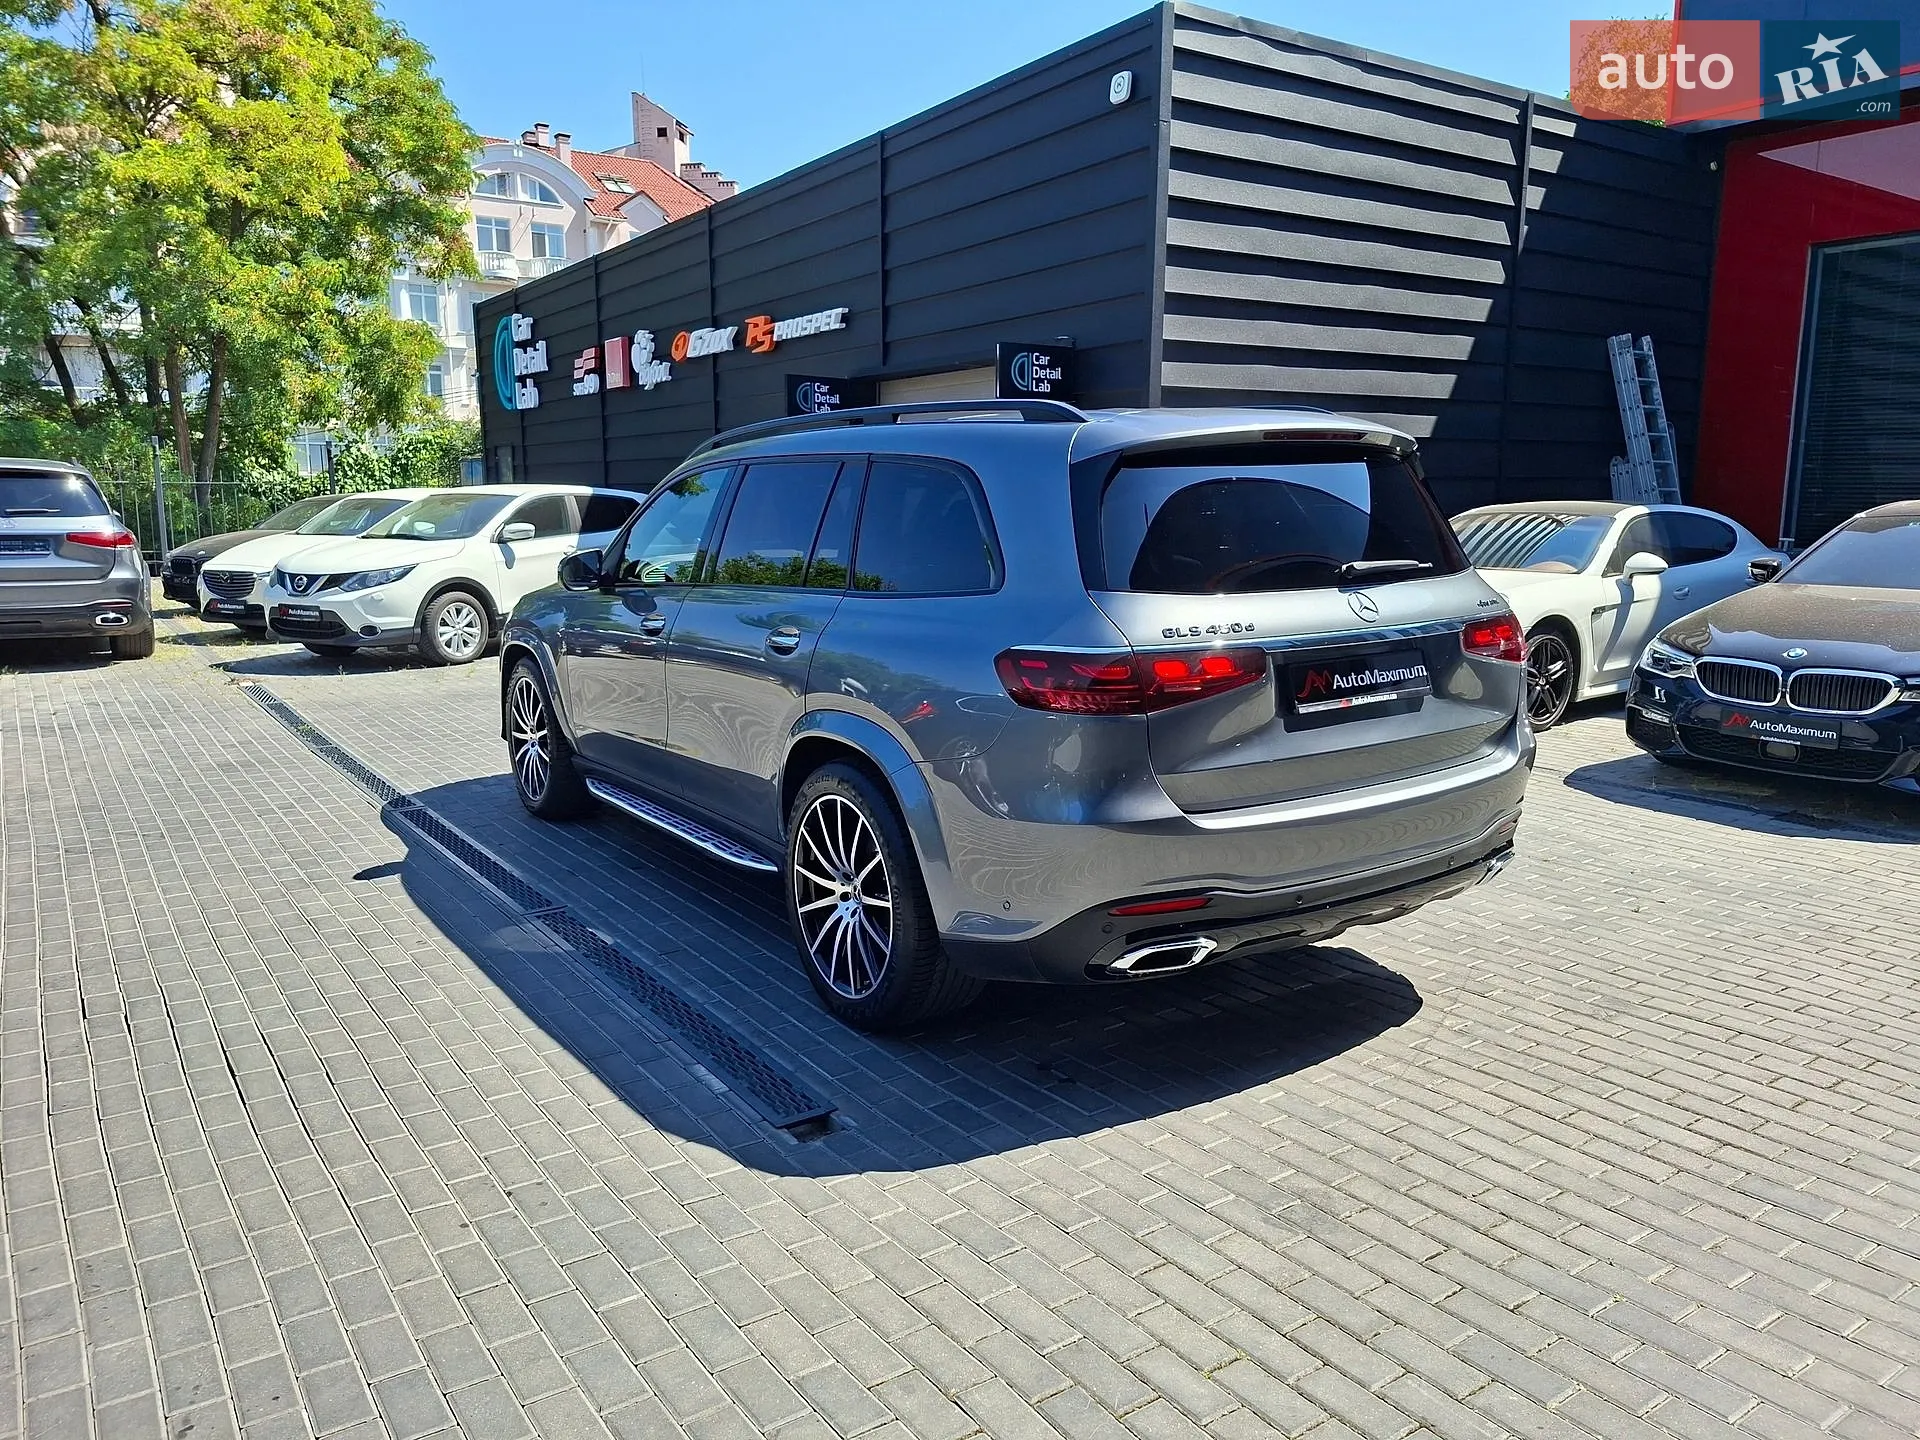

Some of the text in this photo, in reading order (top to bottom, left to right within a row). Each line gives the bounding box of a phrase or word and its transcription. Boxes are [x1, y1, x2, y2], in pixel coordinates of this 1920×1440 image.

[511, 313, 534, 342] Car
[772, 307, 849, 341] PROSPEC
[513, 340, 549, 376] Detail
[1032, 352, 1051, 365] Car
[1032, 366, 1062, 380] Detail
[814, 382, 830, 393] Car
[1032, 379, 1051, 392] Lab
[515, 378, 540, 410] Lab
[814, 393, 840, 404] Detail
[814, 403, 831, 413] Lab
[1161, 626, 1202, 639] GLS
[1332, 664, 1428, 690] AutoMaximum
[1749, 719, 1837, 739] AutoMaximum
